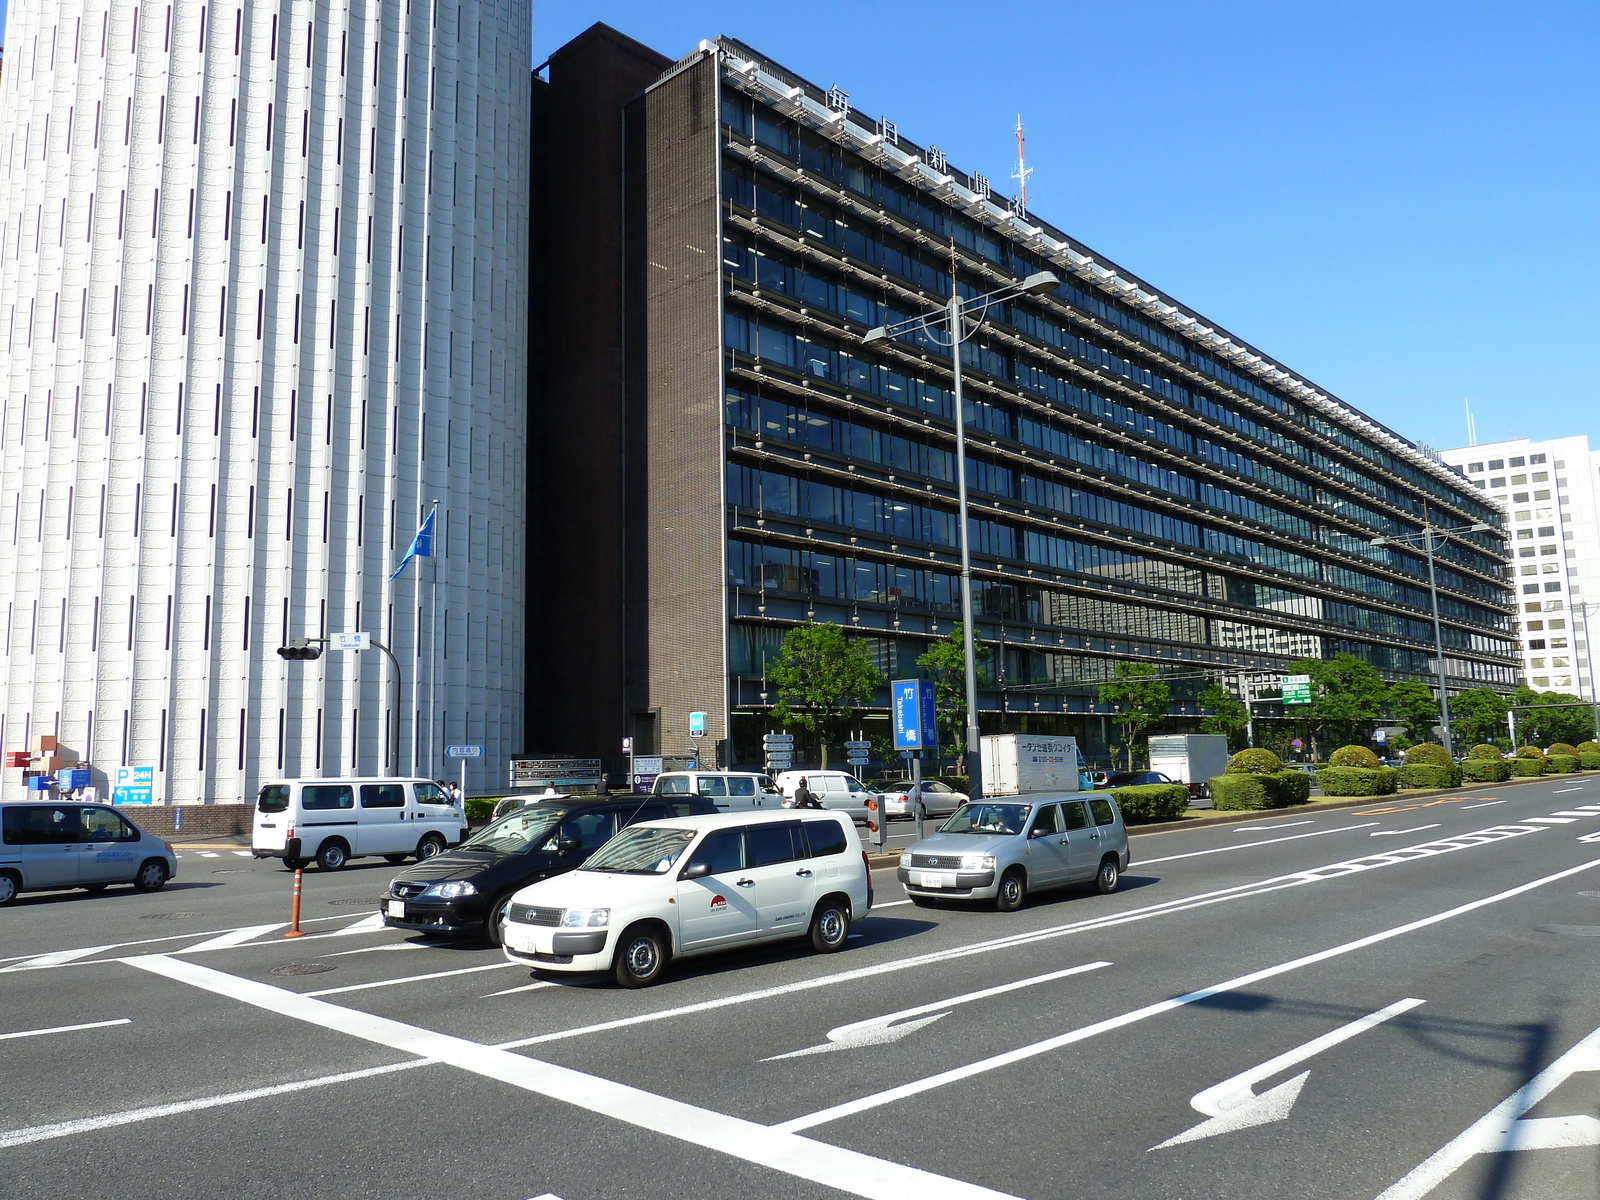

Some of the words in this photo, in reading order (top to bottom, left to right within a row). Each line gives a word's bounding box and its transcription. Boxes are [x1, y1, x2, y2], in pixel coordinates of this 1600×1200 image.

[340, 635, 361, 643] 竹橋
[897, 696, 905, 734] Takebashi
[904, 687, 917, 742] 竹橋
[134, 771, 152, 780] 24H
